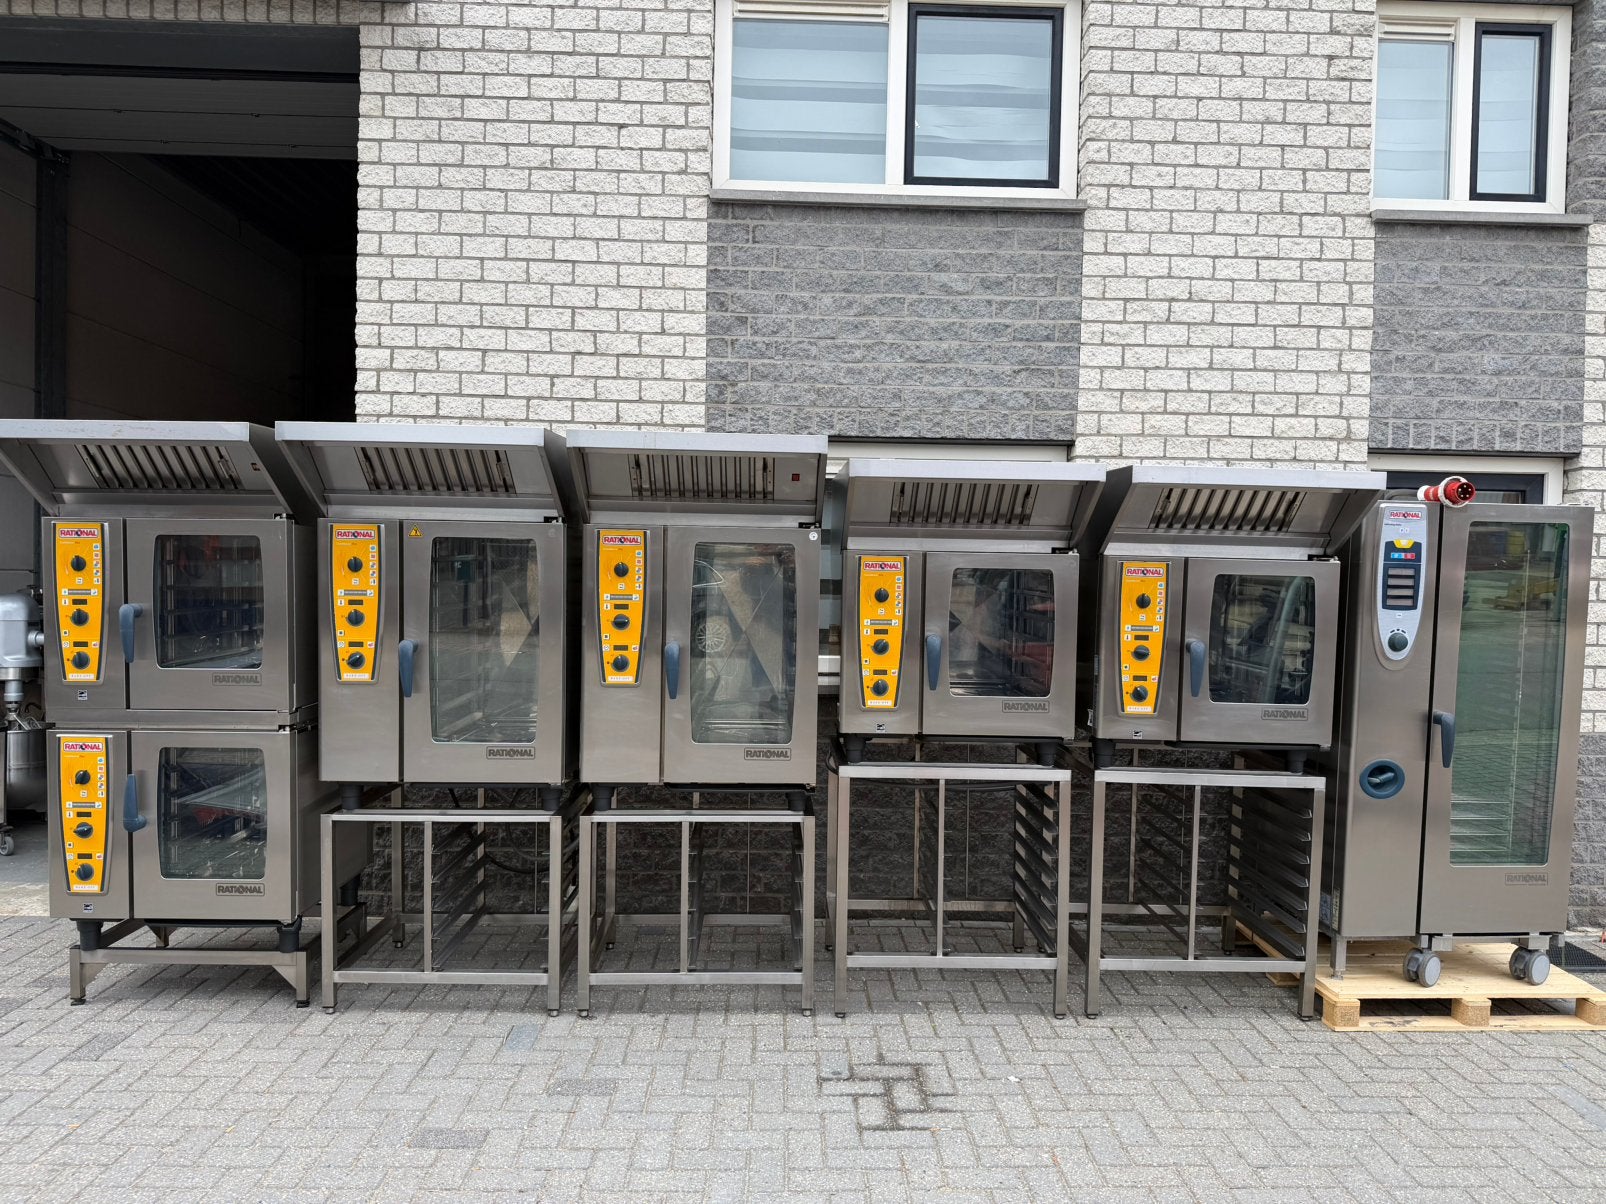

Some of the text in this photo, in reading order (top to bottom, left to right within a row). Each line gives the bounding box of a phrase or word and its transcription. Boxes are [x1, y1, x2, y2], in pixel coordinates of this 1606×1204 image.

[1391, 511, 1420, 519] RATIONAL
[60, 529, 97, 537] RATIONAL
[336, 530, 375, 538] RATIONAL
[603, 536, 640, 544] RATIONAL
[864, 562, 900, 570] RATIONAL
[1126, 568, 1163, 576] RATIONAL
[213, 674, 260, 684] RATIONAL
[1003, 702, 1048, 711] RATIONAL
[1263, 709, 1306, 719] RATIONAL
[64, 743, 102, 751] RATIONAL
[488, 748, 534, 758] RATIONAL
[745, 749, 790, 759] RATIONAL
[1506, 874, 1546, 883] RATIONAL
[217, 885, 263, 894] RATIONAL
